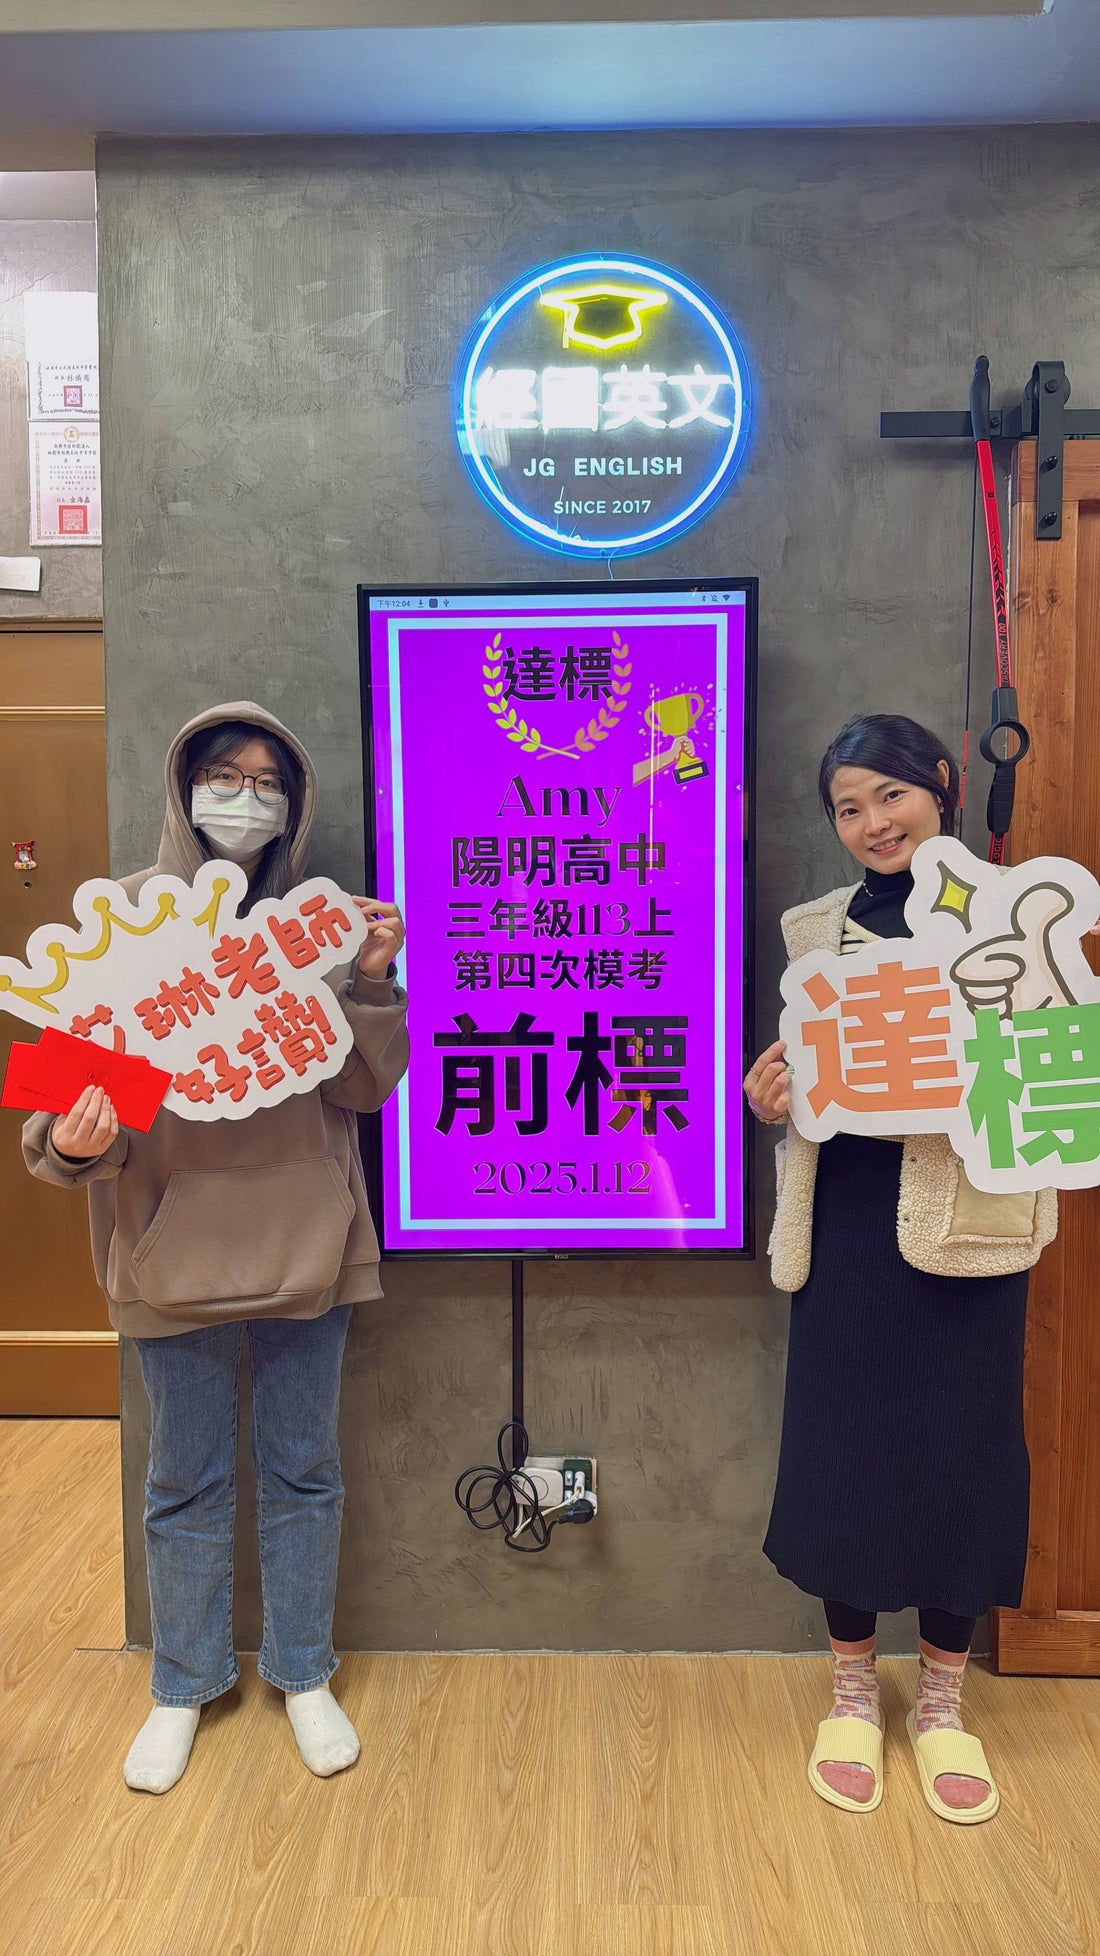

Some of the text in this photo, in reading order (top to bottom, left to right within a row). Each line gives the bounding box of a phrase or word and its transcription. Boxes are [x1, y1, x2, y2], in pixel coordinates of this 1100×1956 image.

[475, 364, 732, 434] 經英文
[523, 457, 682, 476] JG ENGLISH
[553, 499, 651, 514] SINCE 2017
[502, 646, 614, 702] 達標
[496, 775, 622, 827] Amy
[452, 833, 666, 888] 陽明高中
[446, 897, 674, 940] 三年級113上
[453, 948, 668, 992] 第四次模考
[433, 1011, 691, 1137] 前標
[473, 1161, 651, 1195] 2025.1.12
